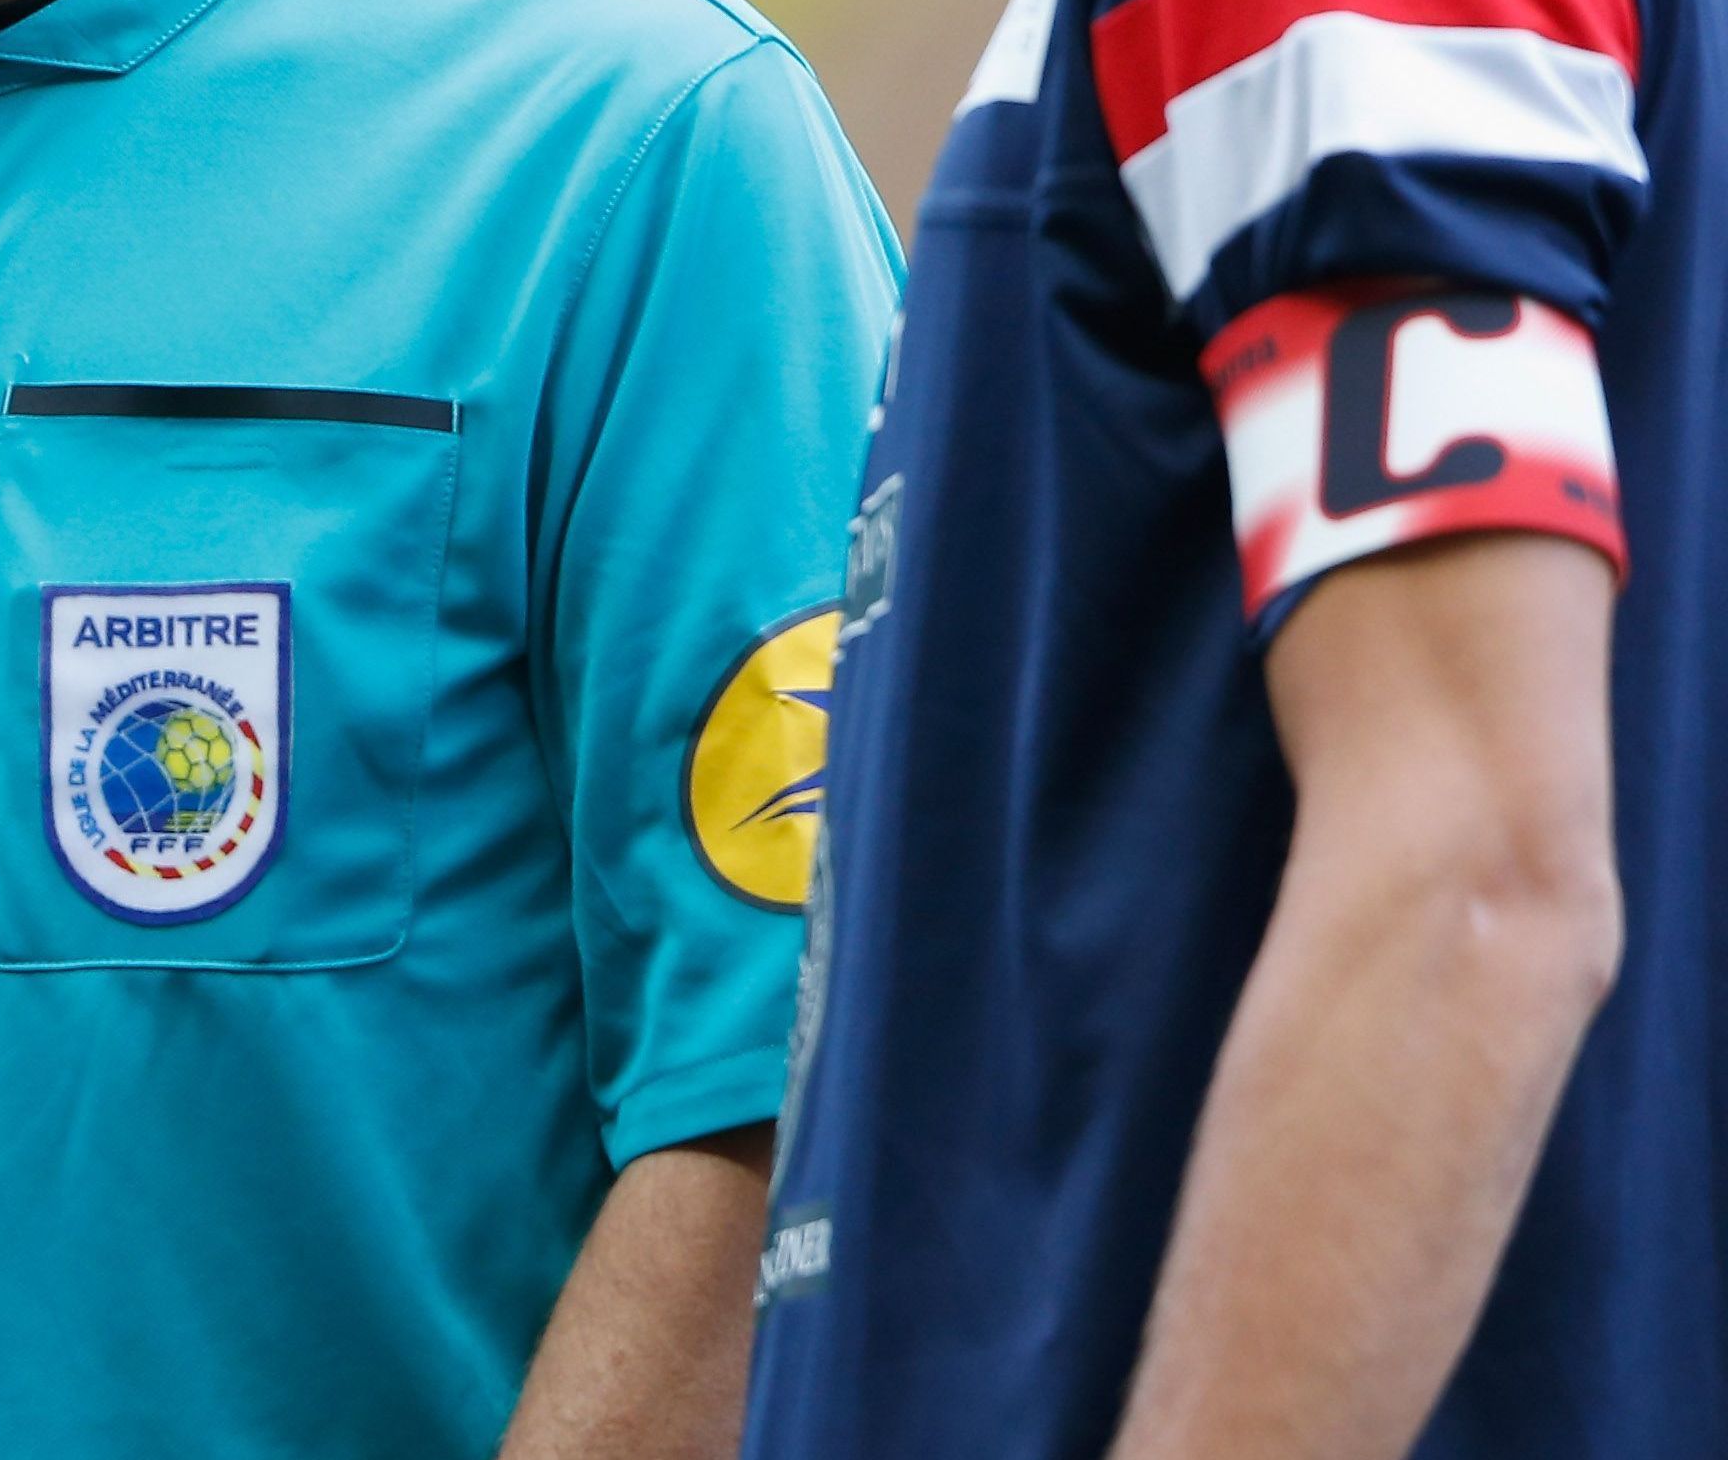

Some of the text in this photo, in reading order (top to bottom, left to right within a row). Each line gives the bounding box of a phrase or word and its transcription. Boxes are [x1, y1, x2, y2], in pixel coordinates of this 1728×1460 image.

[1320, 291, 1522, 522] C
[73, 613, 260, 649] ARBITRE
[75, 726, 97, 752] LA
[68, 758, 87, 786] DE
